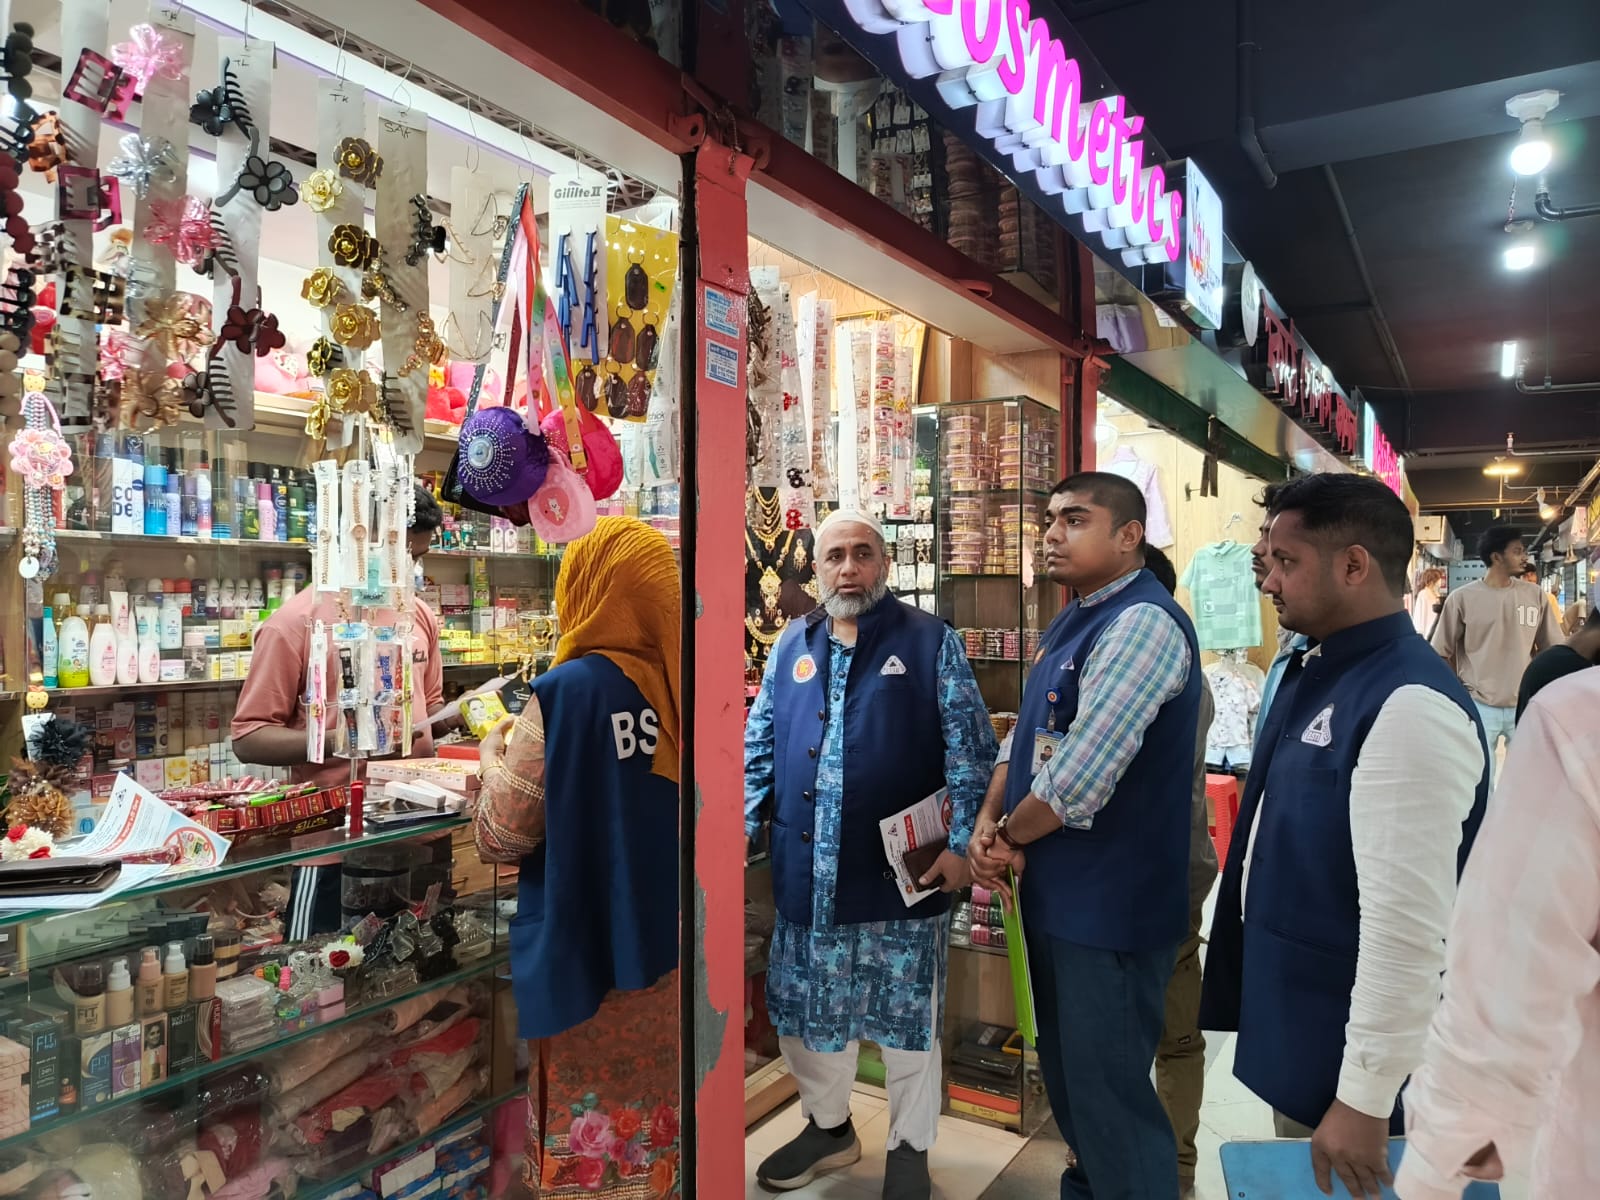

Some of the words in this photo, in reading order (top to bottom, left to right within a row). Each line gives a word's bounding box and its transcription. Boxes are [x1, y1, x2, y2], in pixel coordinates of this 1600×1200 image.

[922, 0, 1182, 262] osmetics
[1517, 605, 1539, 627] 10
[611, 708, 658, 760] BS
[36, 1032, 56, 1053] FIT
